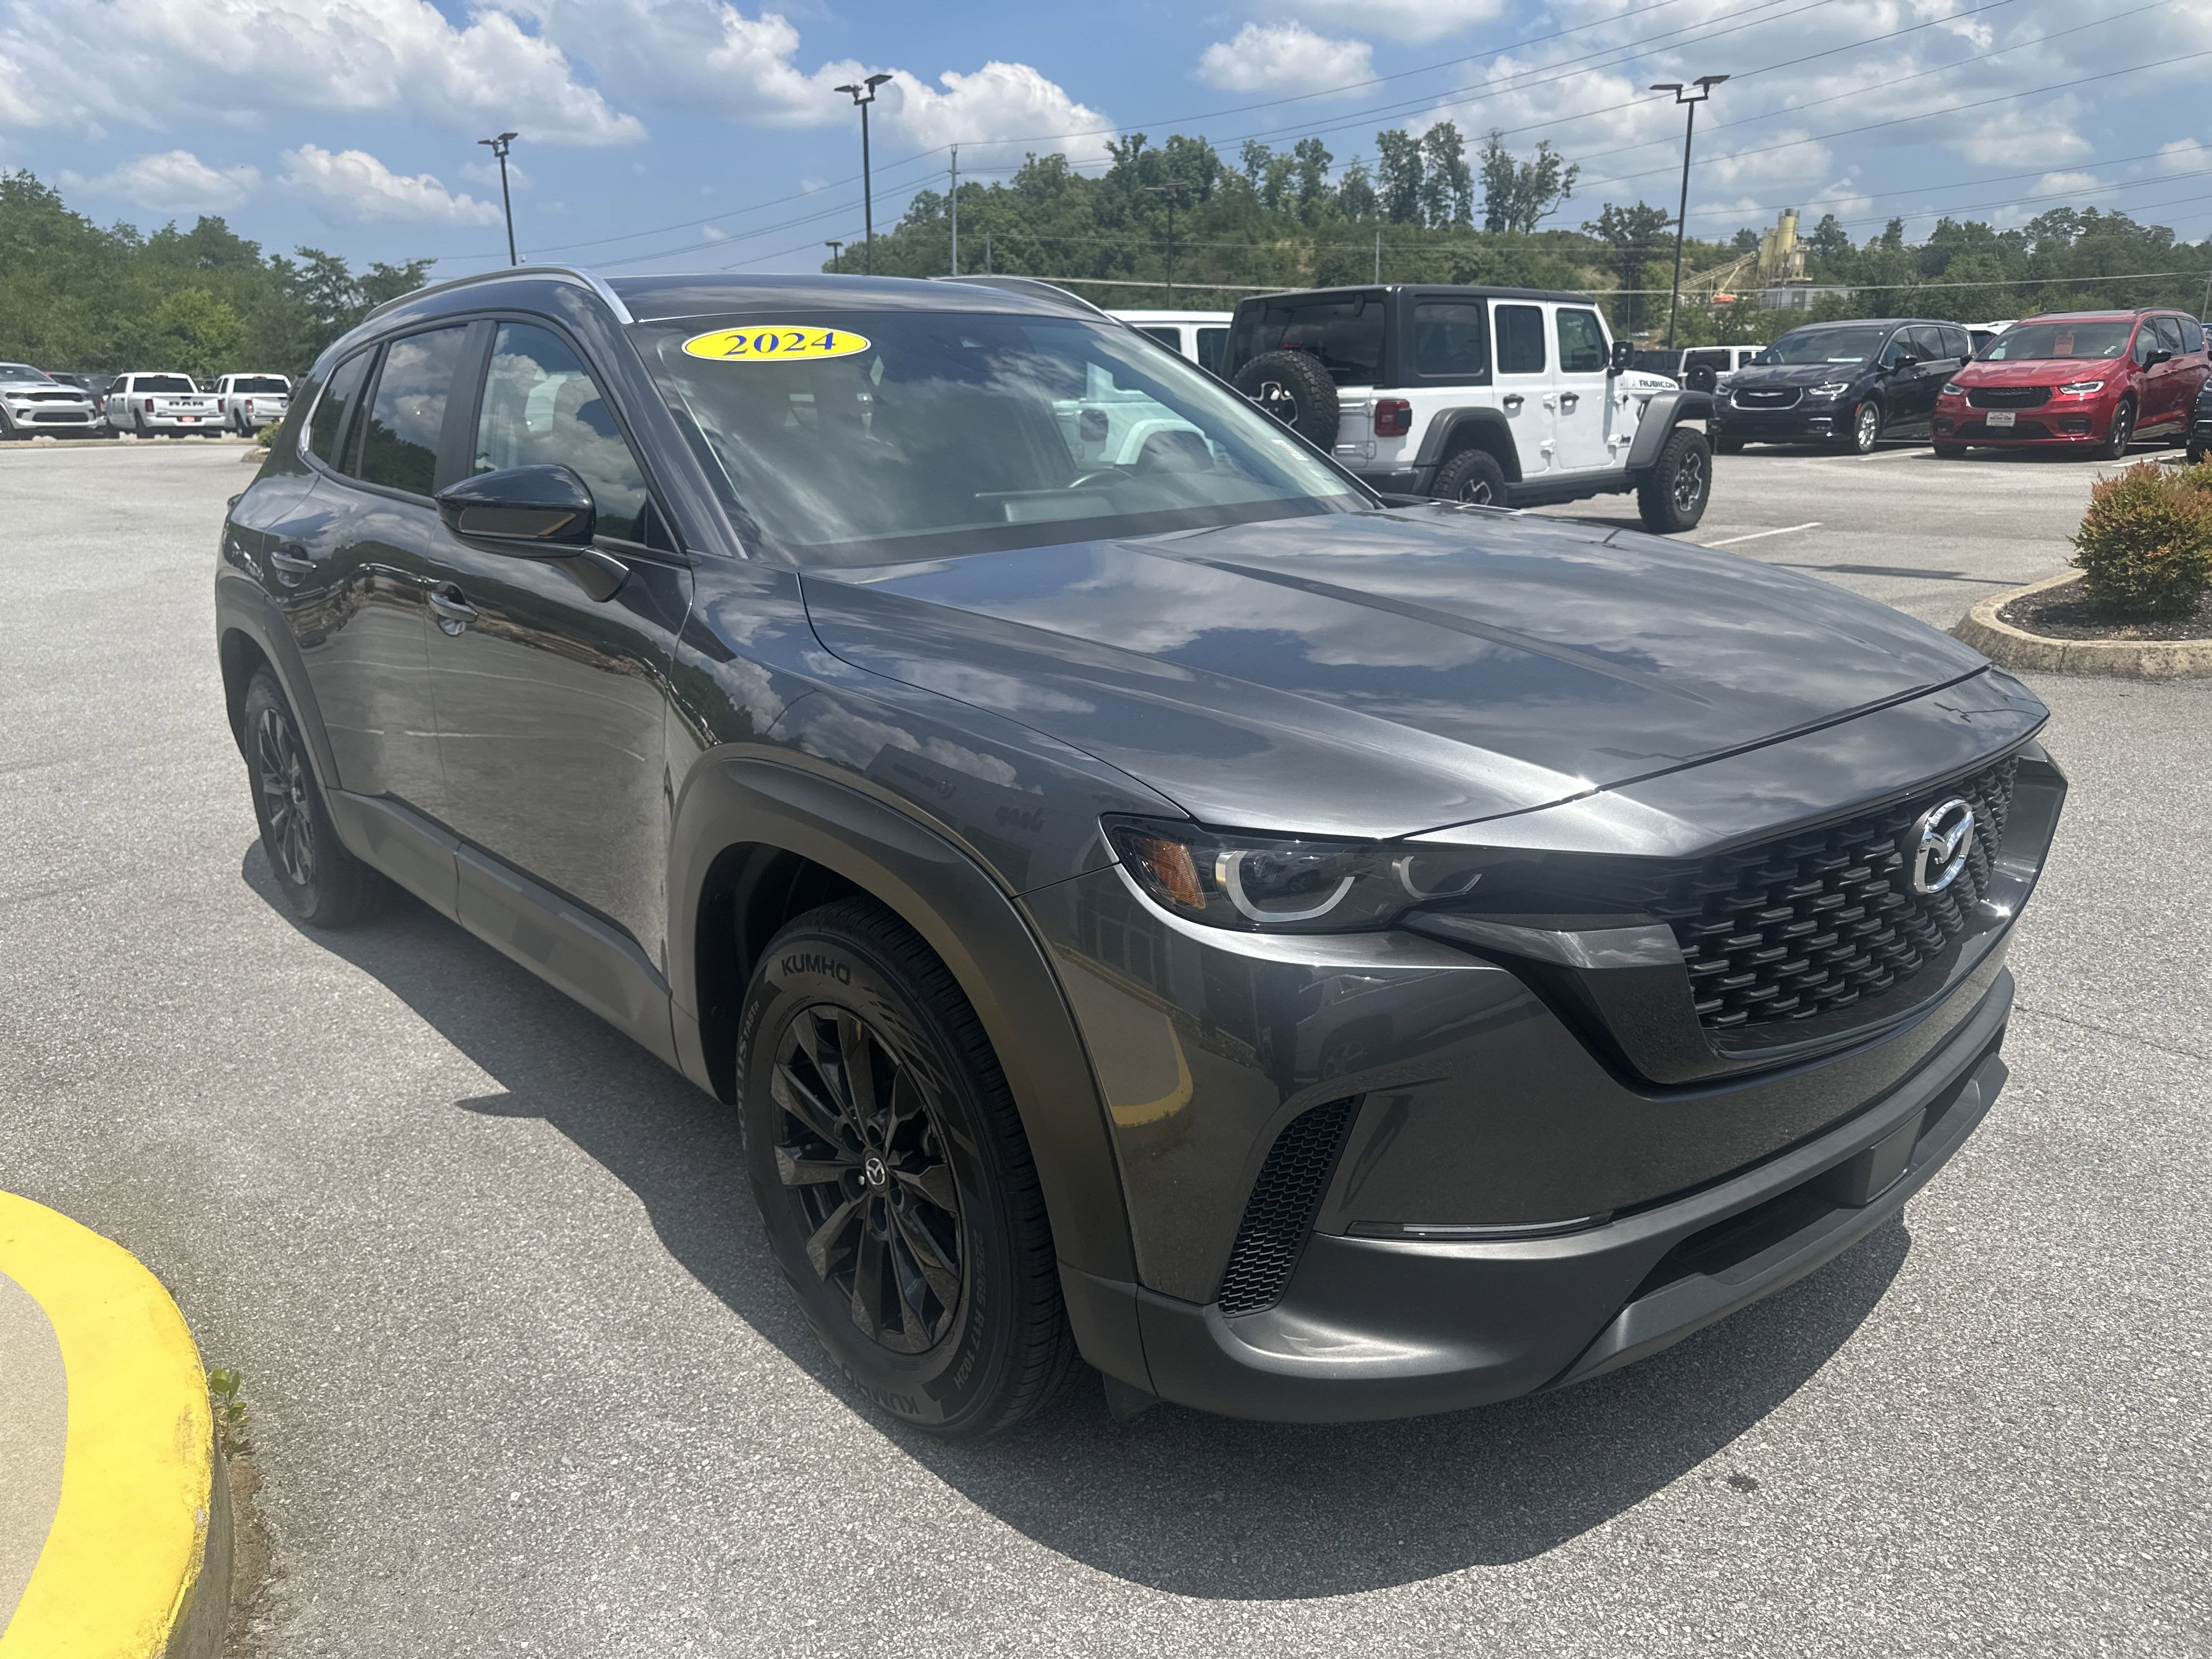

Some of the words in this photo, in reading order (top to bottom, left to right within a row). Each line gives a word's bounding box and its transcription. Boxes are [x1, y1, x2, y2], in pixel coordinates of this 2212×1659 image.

[723, 331, 837, 356] 2024
[1639, 380, 1676, 389] RUBICON
[781, 953, 851, 986] KUMHO
[953, 1348, 975, 1390] 102H
